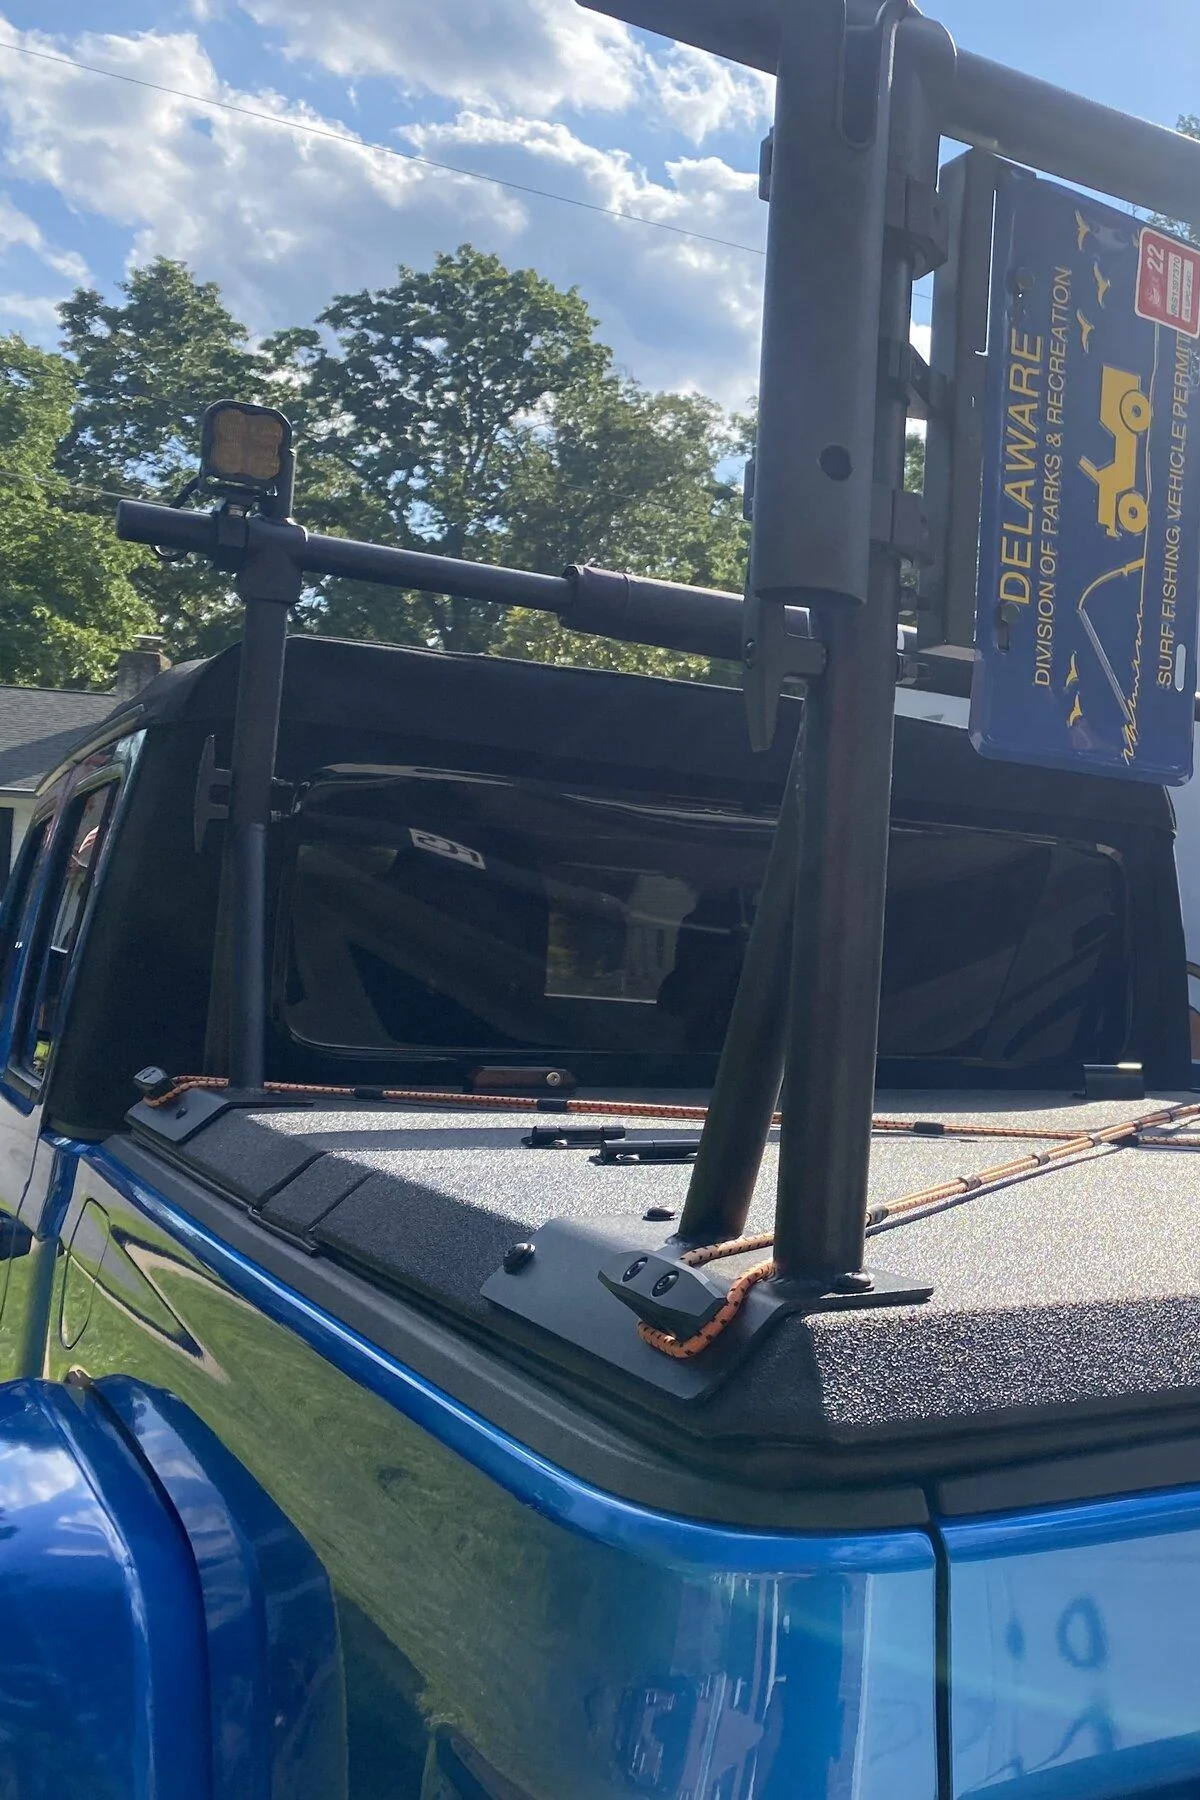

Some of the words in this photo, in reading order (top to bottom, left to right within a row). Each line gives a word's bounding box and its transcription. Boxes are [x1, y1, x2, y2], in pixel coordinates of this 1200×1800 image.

[1147, 244, 1164, 274] 22
[1046, 267, 1072, 425] RECREATION
[1172, 332, 1192, 418] PERMIT
[999, 327, 1043, 605] DELAWARE
[1045, 432, 1062, 448] &
[1167, 423, 1187, 521] VEHICLE
[1041, 453, 1062, 535] PARKS
[1039, 539, 1057, 576] OF
[1162, 526, 1181, 619] FISHING
[1034, 581, 1056, 686] DIVISION
[1158, 623, 1176, 686] SURF
